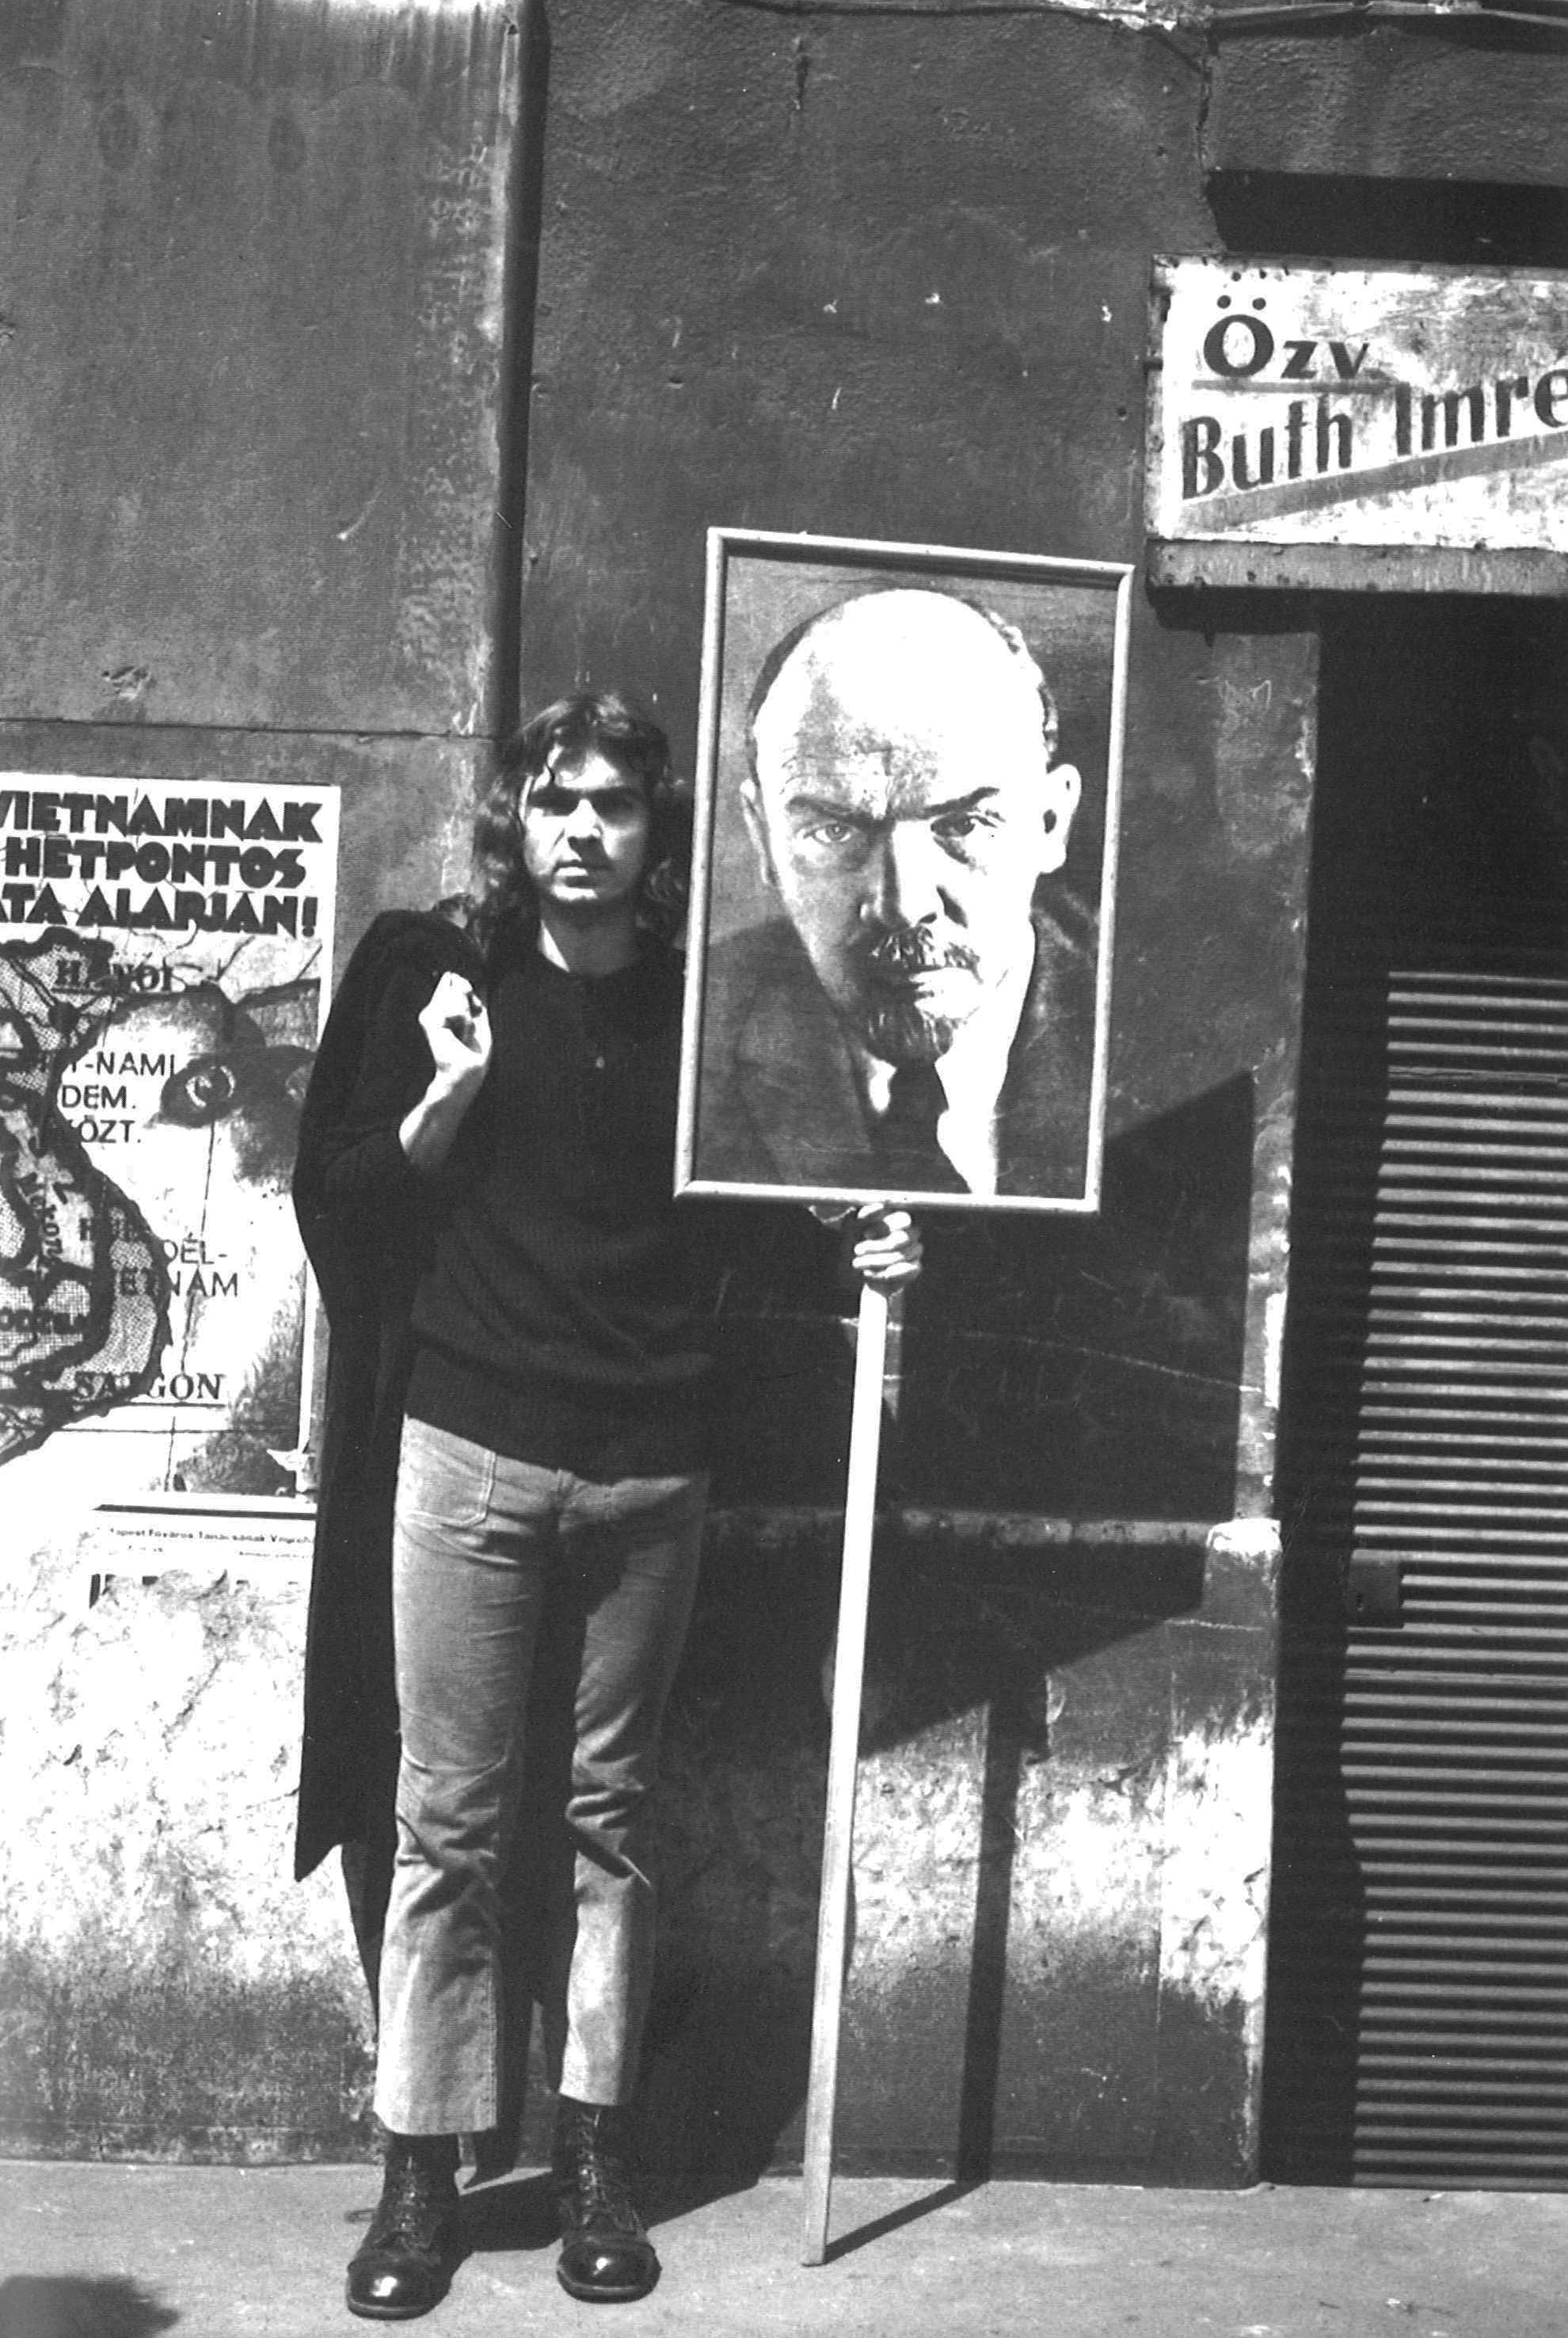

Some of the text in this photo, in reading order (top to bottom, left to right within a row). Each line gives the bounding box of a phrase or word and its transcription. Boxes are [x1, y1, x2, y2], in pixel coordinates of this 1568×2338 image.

[1183, 394, 1353, 501] Buth
[61, 1084, 136, 1109] DEM.
[68, 1114, 142, 1144] ÖZT.
